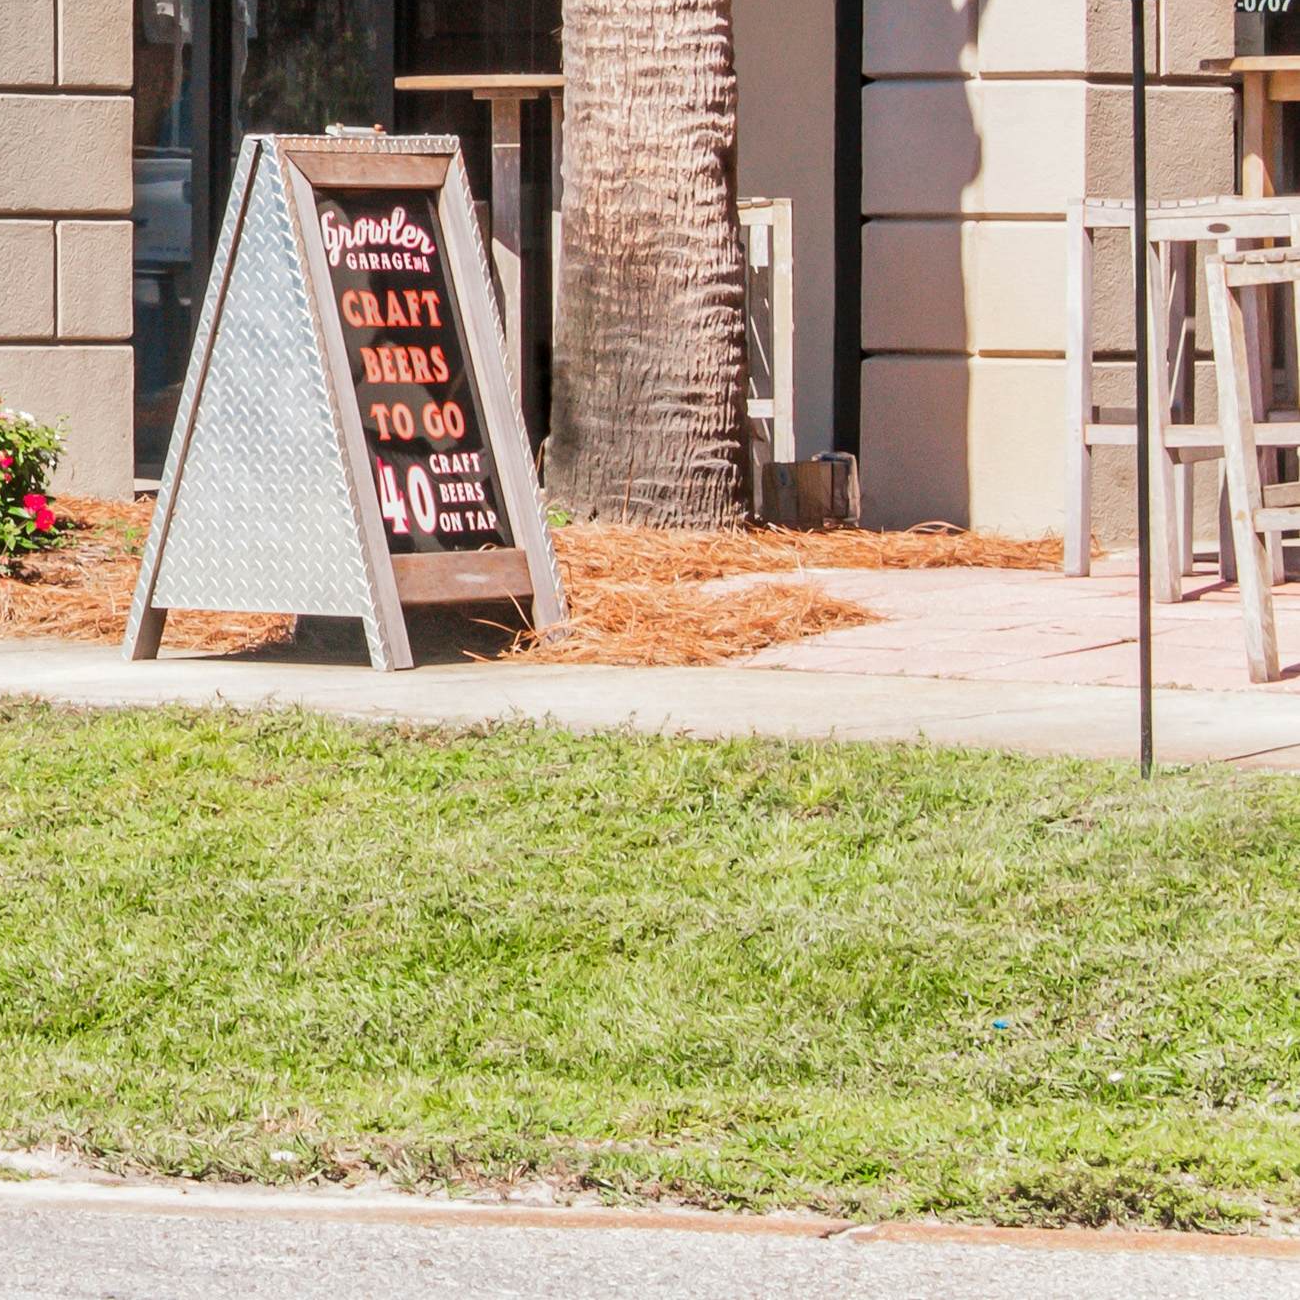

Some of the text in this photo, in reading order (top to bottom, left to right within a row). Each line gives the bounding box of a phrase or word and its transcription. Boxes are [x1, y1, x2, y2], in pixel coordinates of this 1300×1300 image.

[320, 206, 435, 267] Growler
[346, 252, 413, 271] GARAGE
[342, 289, 442, 327] CRAFT
[360, 345, 450, 384] BEERS
[370, 402, 465, 441] TO GO
[429, 453, 481, 474] CRAFT
[377, 455, 436, 535] 40
[440, 482, 485, 503] BEERS
[439, 511, 497, 532] ON TAP
